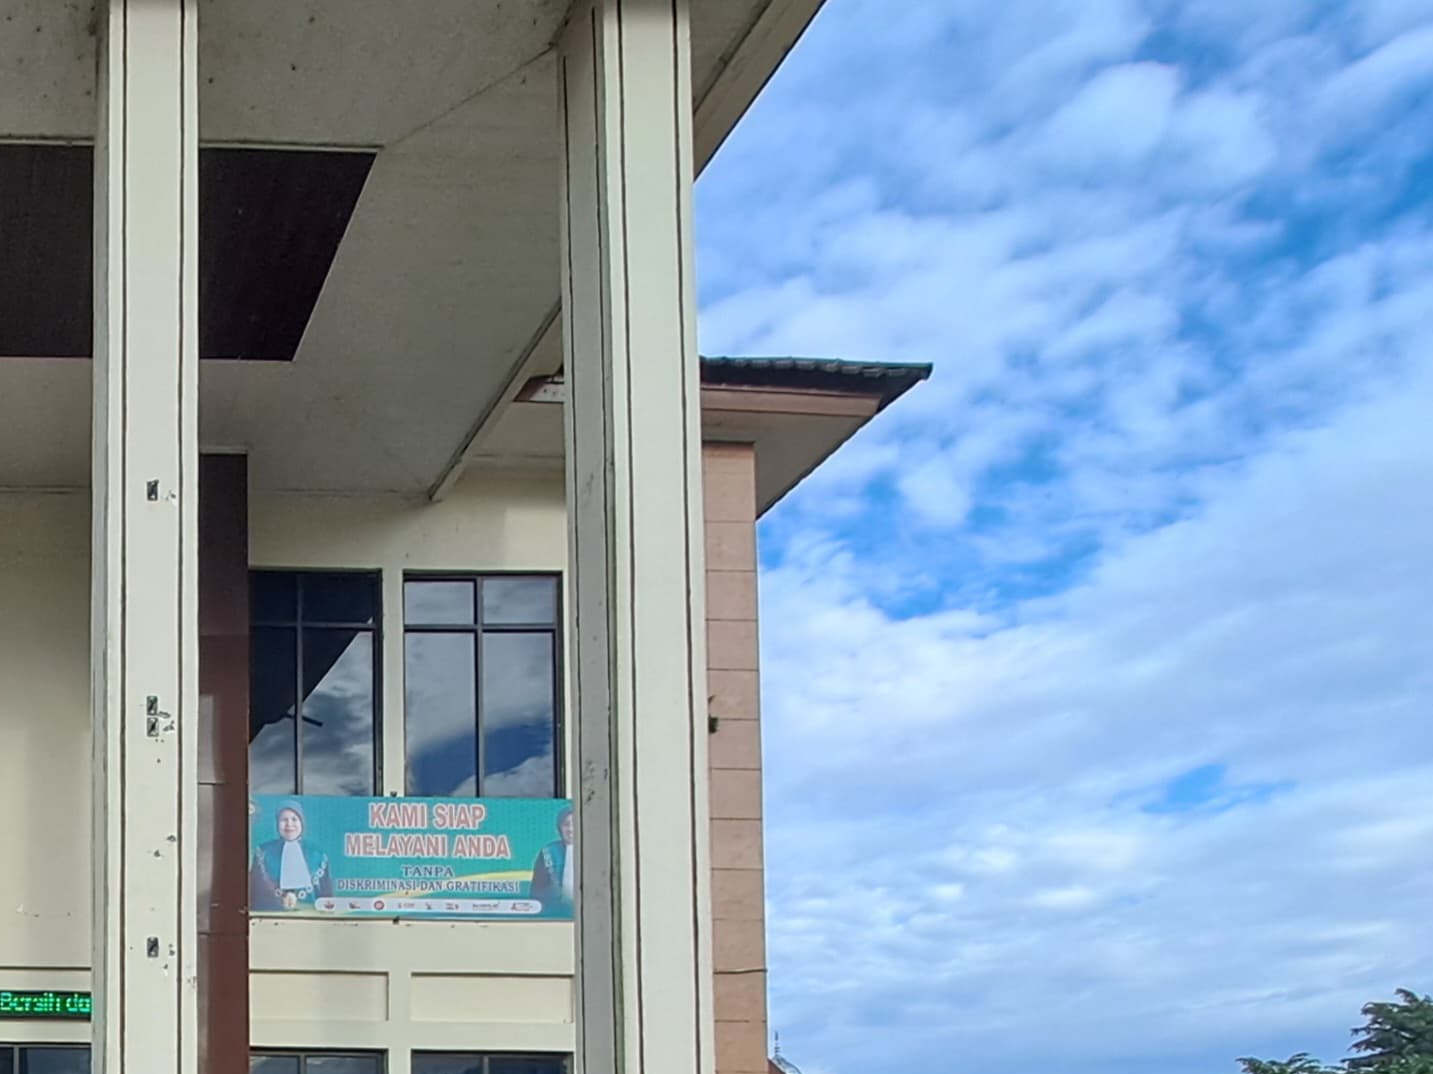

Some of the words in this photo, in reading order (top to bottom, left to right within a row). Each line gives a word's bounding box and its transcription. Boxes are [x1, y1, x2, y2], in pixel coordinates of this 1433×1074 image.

[369, 803, 427, 829] KAMI
[434, 804, 486, 830] SIAP
[345, 833, 449, 857] MELAYANI
[454, 834, 511, 858] ANDA
[403, 866, 454, 877] TANPA
[337, 879, 416, 891] DISKRIMINASI
[420, 880, 443, 891] DAN
[446, 880, 519, 893] GRATIFIKASI
[0, 992, 60, 1011] Bersih
